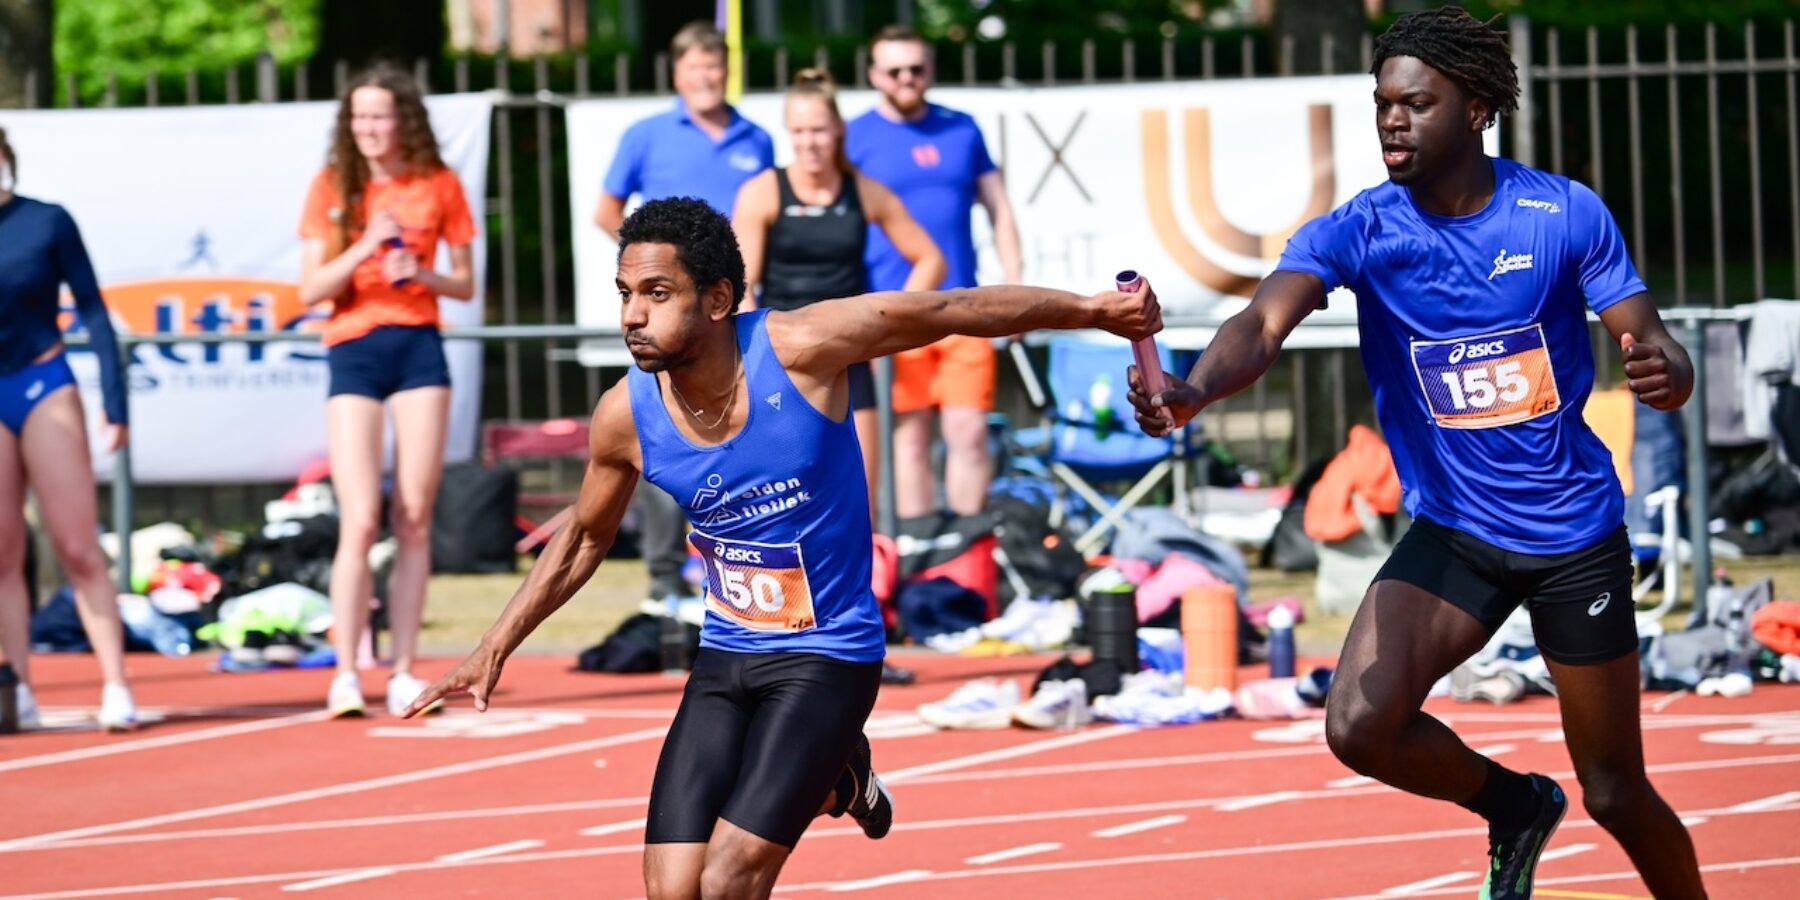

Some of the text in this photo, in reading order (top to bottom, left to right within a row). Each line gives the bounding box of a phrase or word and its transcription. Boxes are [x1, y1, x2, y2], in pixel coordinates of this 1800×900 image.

[1516, 198, 1552, 210] CRAFT
[1441, 361, 1530, 410] 155
[713, 558, 786, 613] 150
